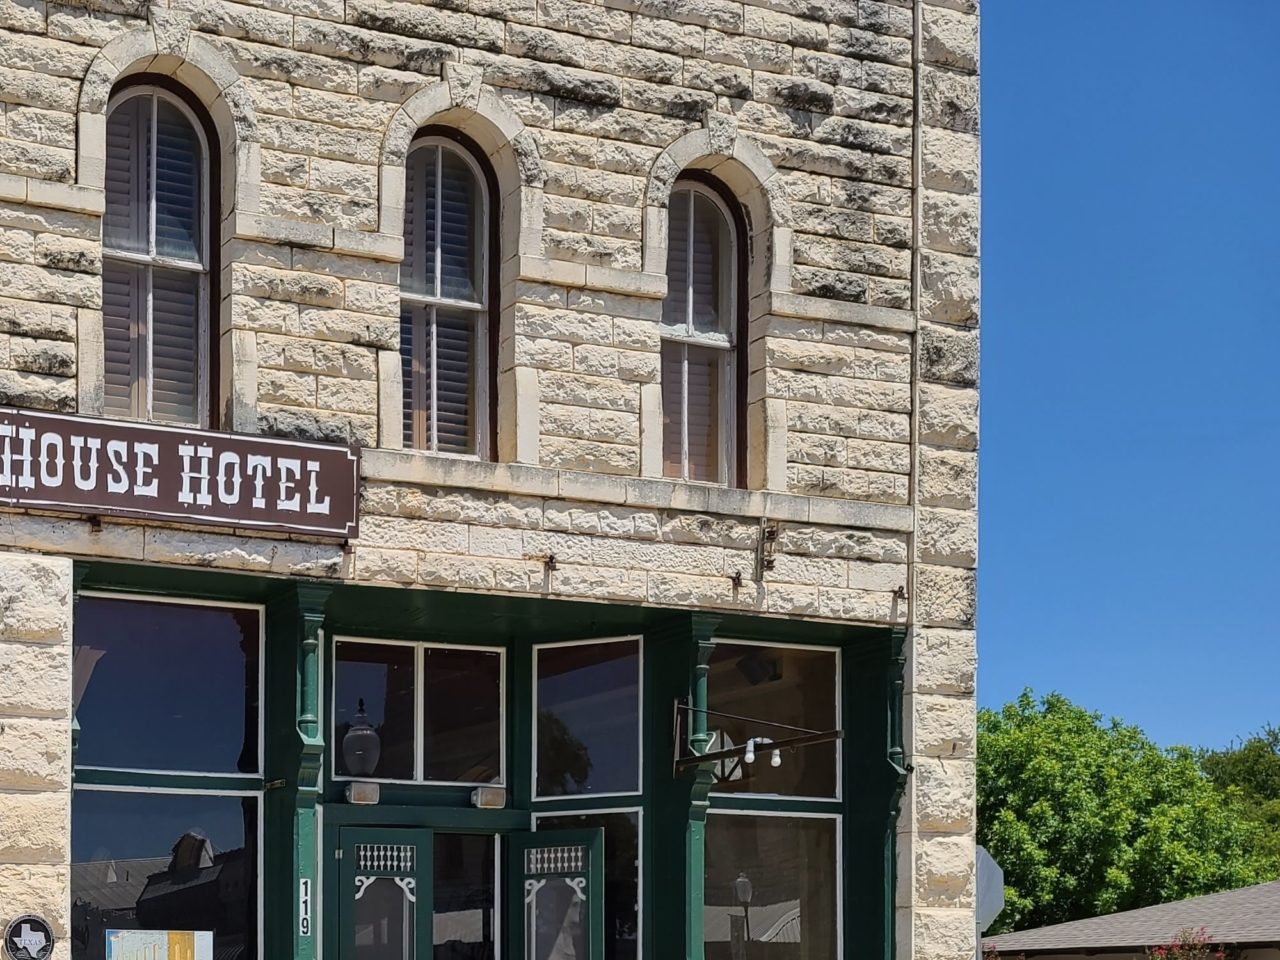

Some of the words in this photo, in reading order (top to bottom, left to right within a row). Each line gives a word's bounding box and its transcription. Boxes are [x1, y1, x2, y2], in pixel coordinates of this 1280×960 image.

[178, 439, 331, 515] HOTEL
[301, 880, 309, 935] 119
[19, 938, 43, 946] TEXAS
